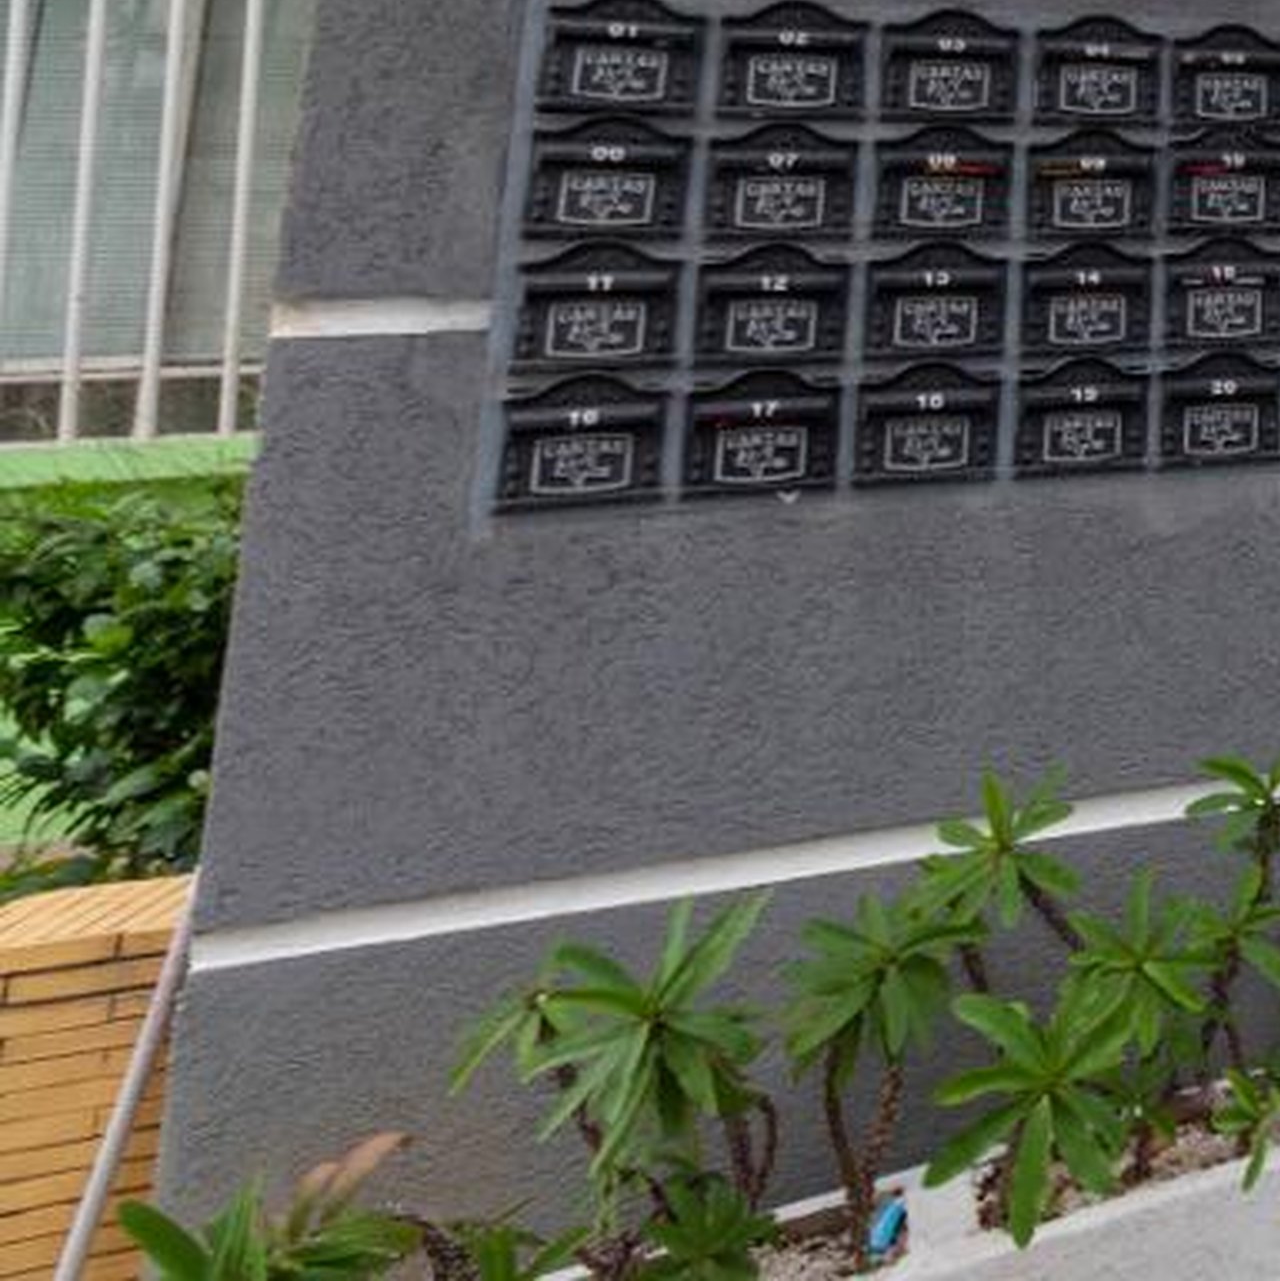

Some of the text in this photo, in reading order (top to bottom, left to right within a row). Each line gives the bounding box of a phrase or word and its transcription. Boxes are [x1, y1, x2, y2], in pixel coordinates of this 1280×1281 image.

[608, 24, 639, 37] 01
[760, 275, 789, 291] 12
[1210, 380, 1238, 395] 20
[751, 401, 781, 418] 17
